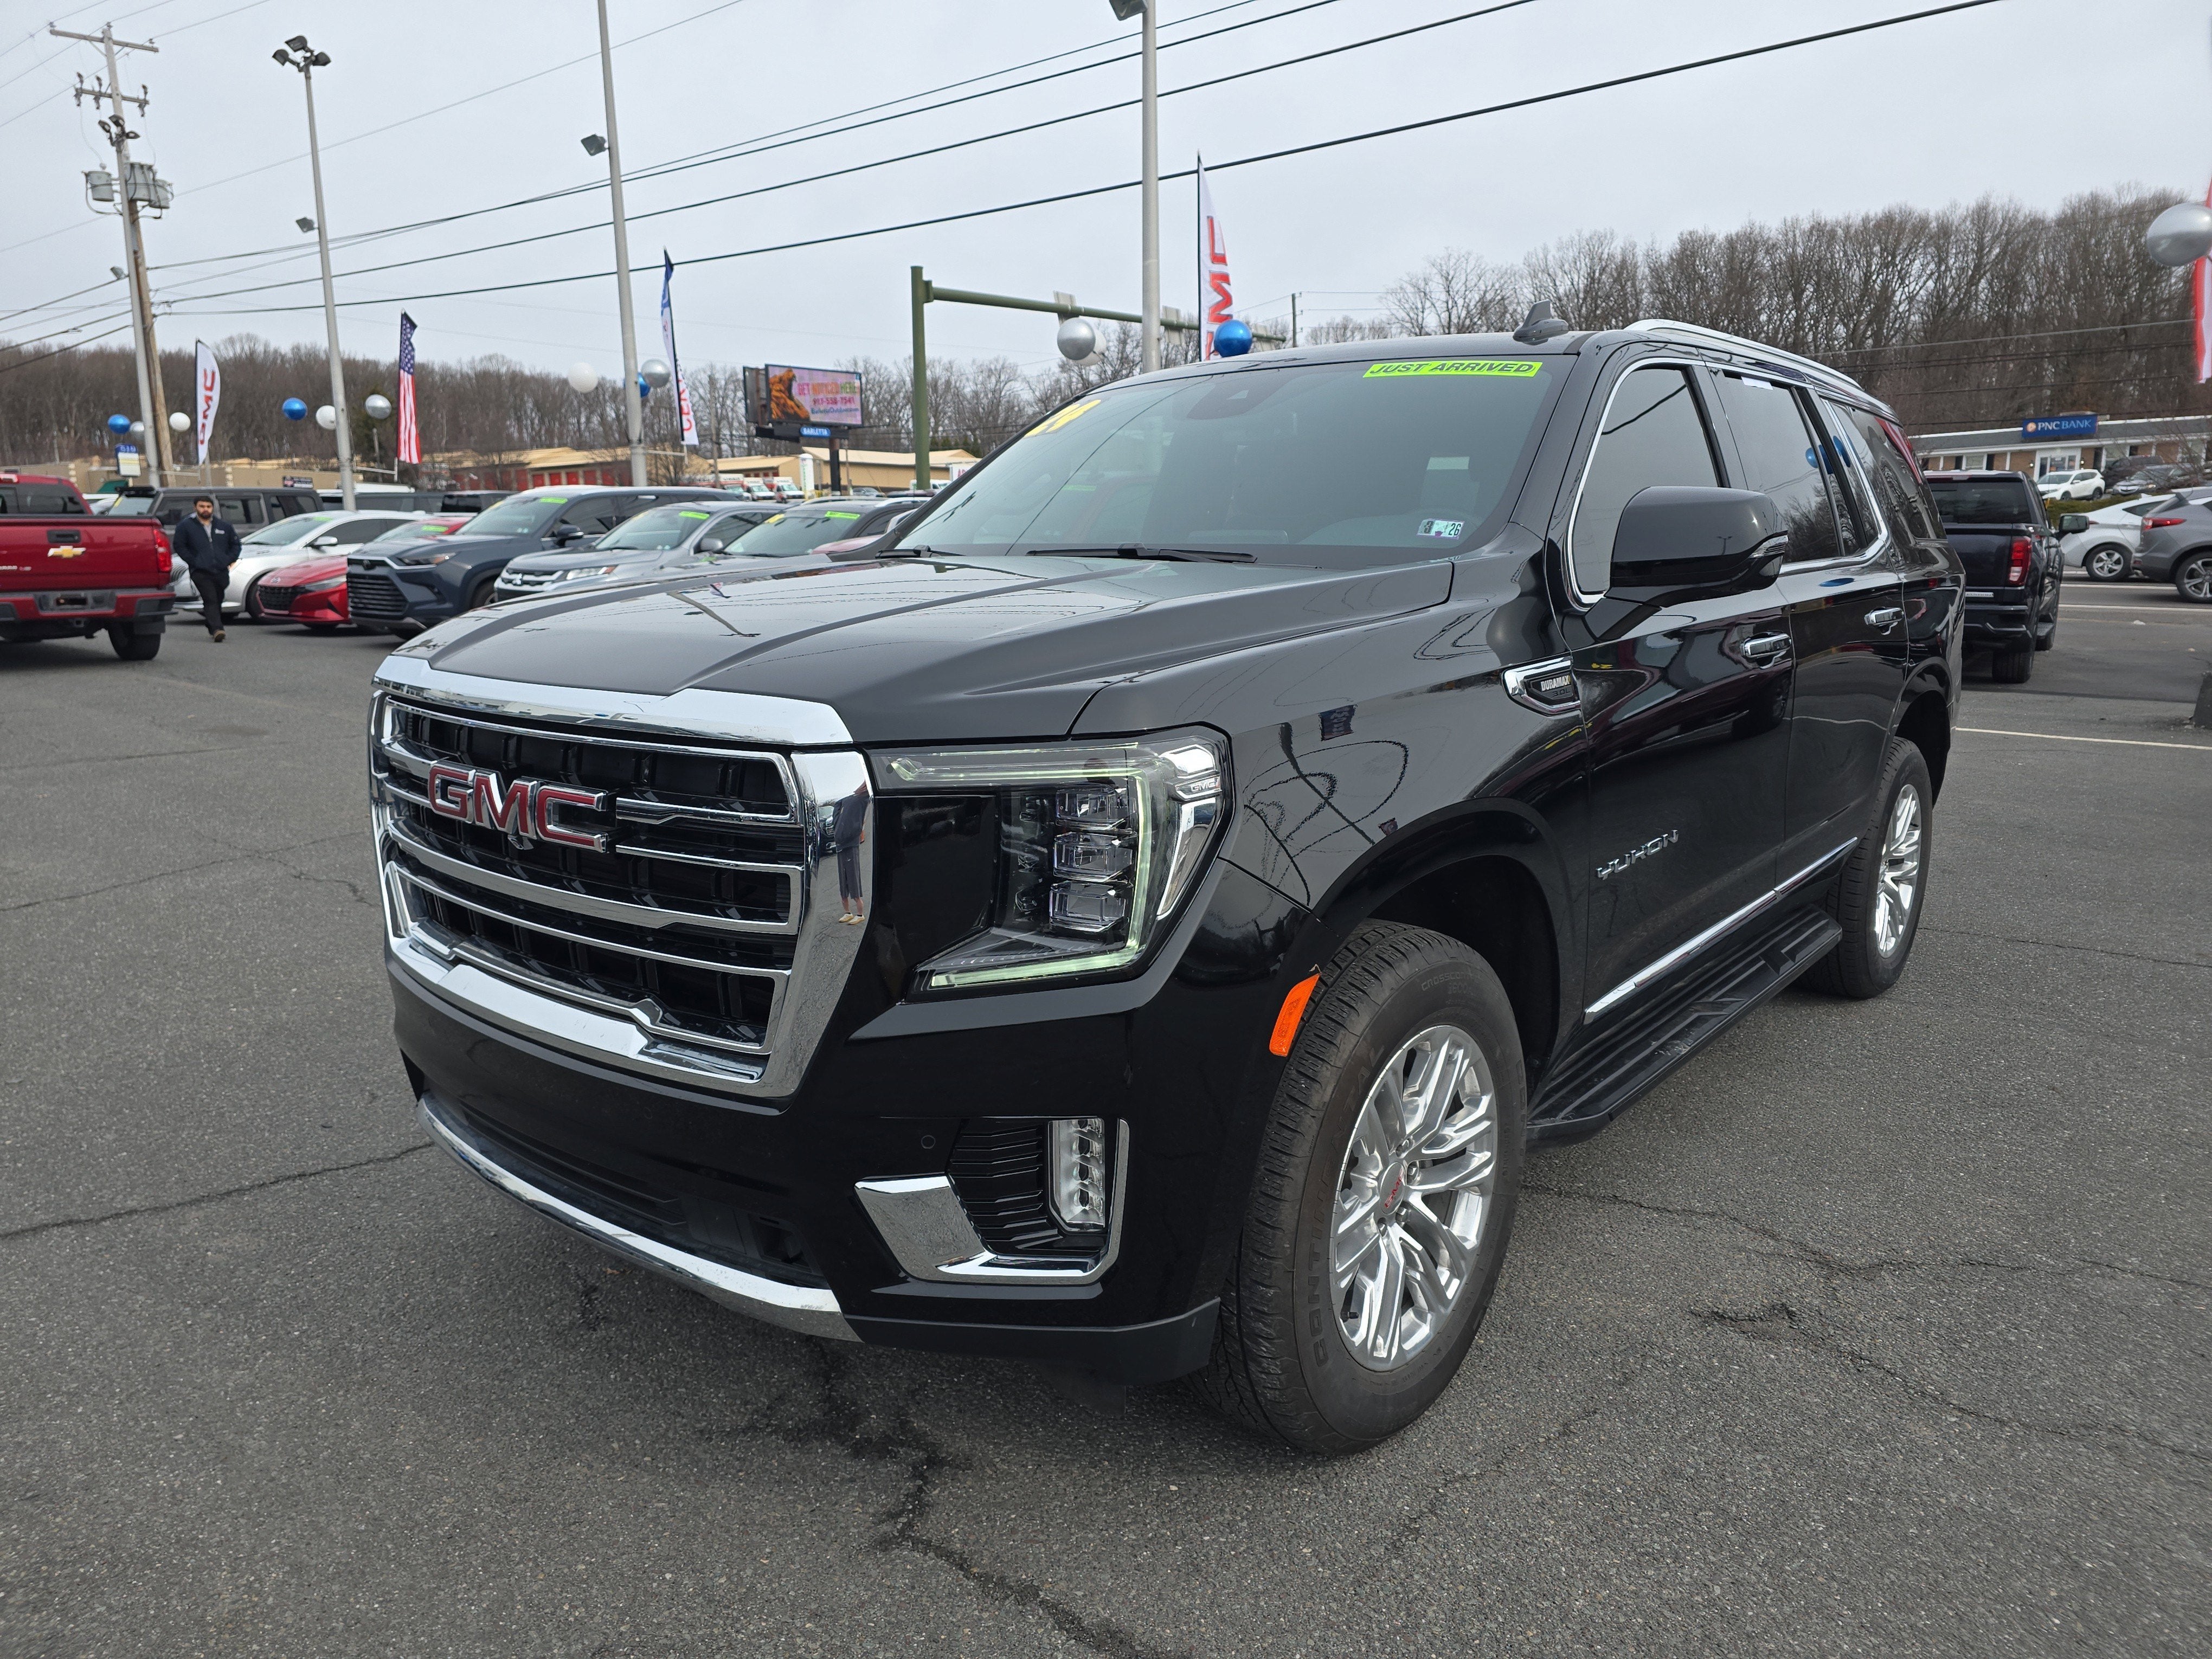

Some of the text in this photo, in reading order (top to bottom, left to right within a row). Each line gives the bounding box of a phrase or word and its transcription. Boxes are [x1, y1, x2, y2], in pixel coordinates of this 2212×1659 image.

[1369, 362, 1538, 375] JUST ARRIVED
[2038, 419, 2092, 431] PNC BANK
[1448, 523, 1462, 536] 26
[1541, 675, 1570, 691] DURAMAX
[1190, 777, 1217, 792] GMC
[428, 761, 608, 853] GMC
[1596, 829, 1679, 880] YUKON
[1384, 1167, 1404, 1208] GMC
